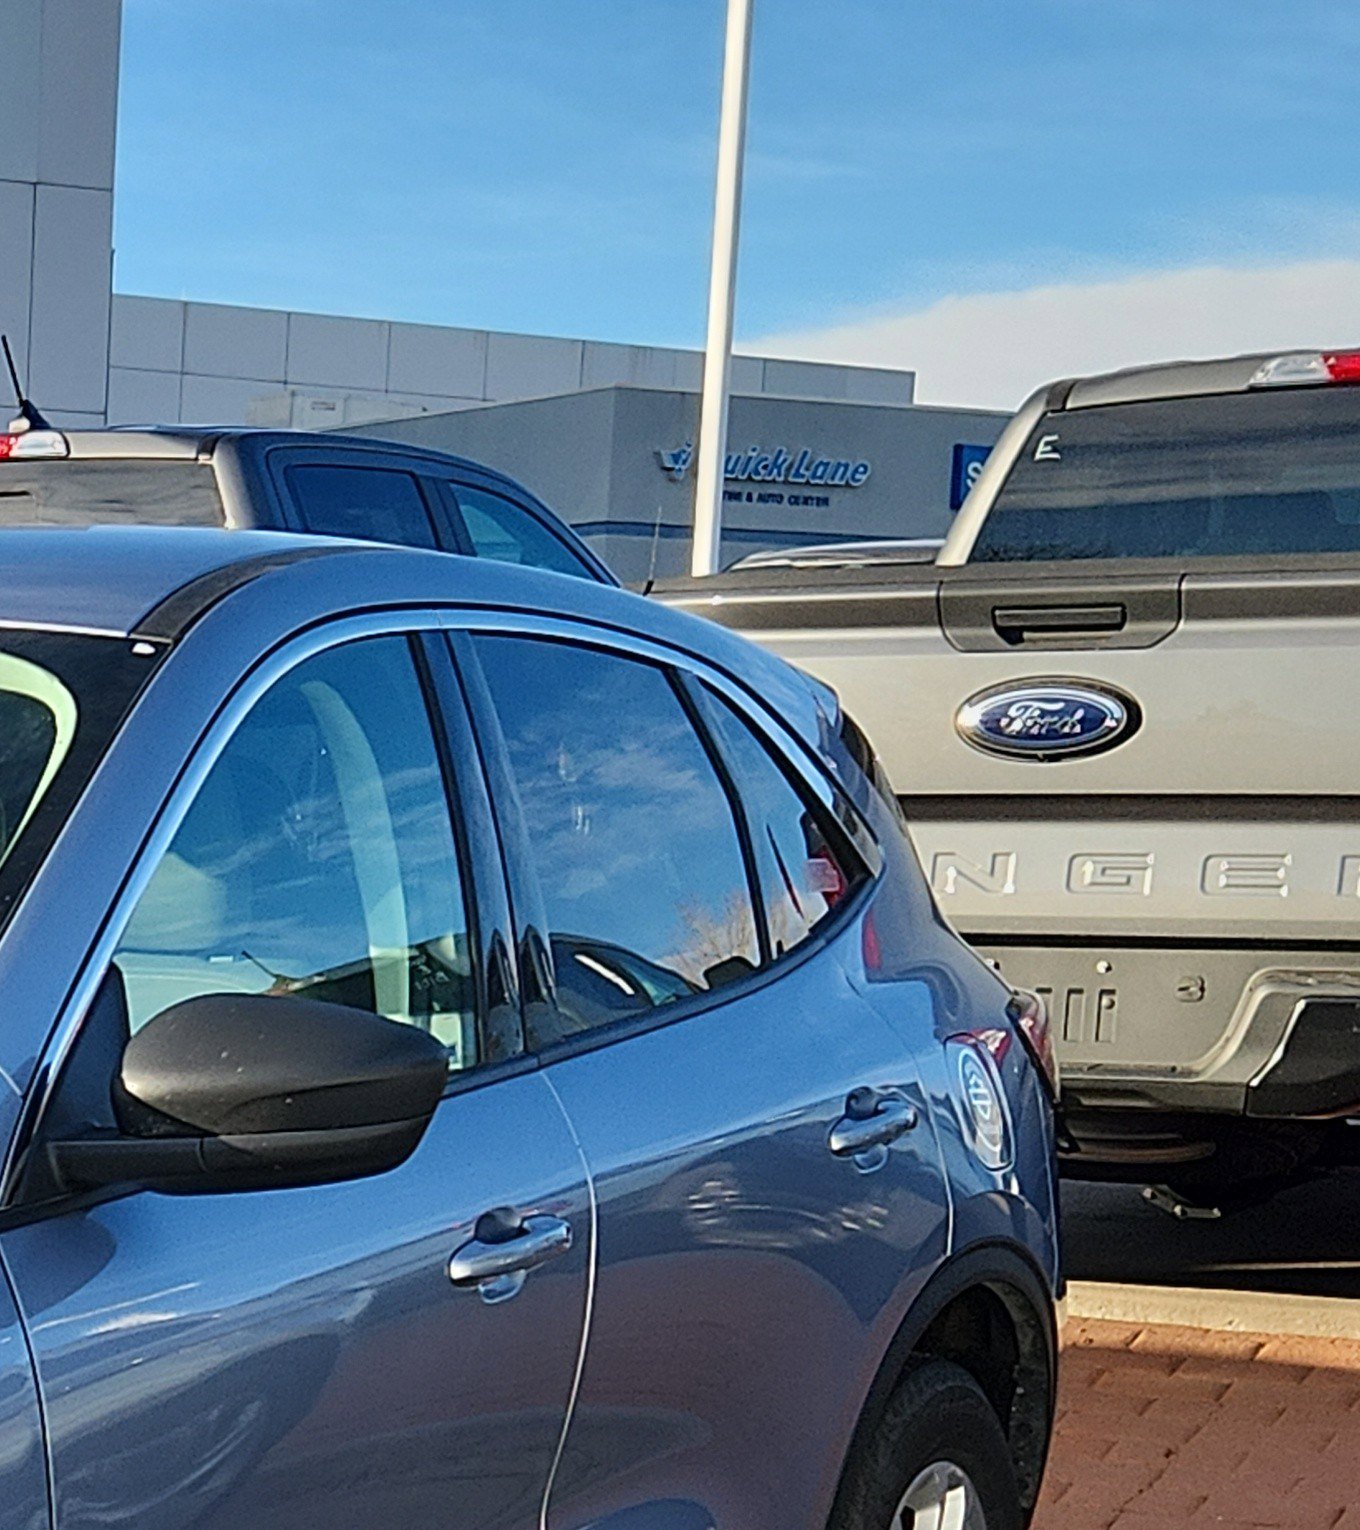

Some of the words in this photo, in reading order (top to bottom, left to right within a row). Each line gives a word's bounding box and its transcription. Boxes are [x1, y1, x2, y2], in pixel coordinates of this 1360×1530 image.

[789, 447, 871, 488] Lane
[756, 492, 784, 505] AUTO
[999, 700, 1084, 736] Ford
[932, 851, 1360, 898] NGE
